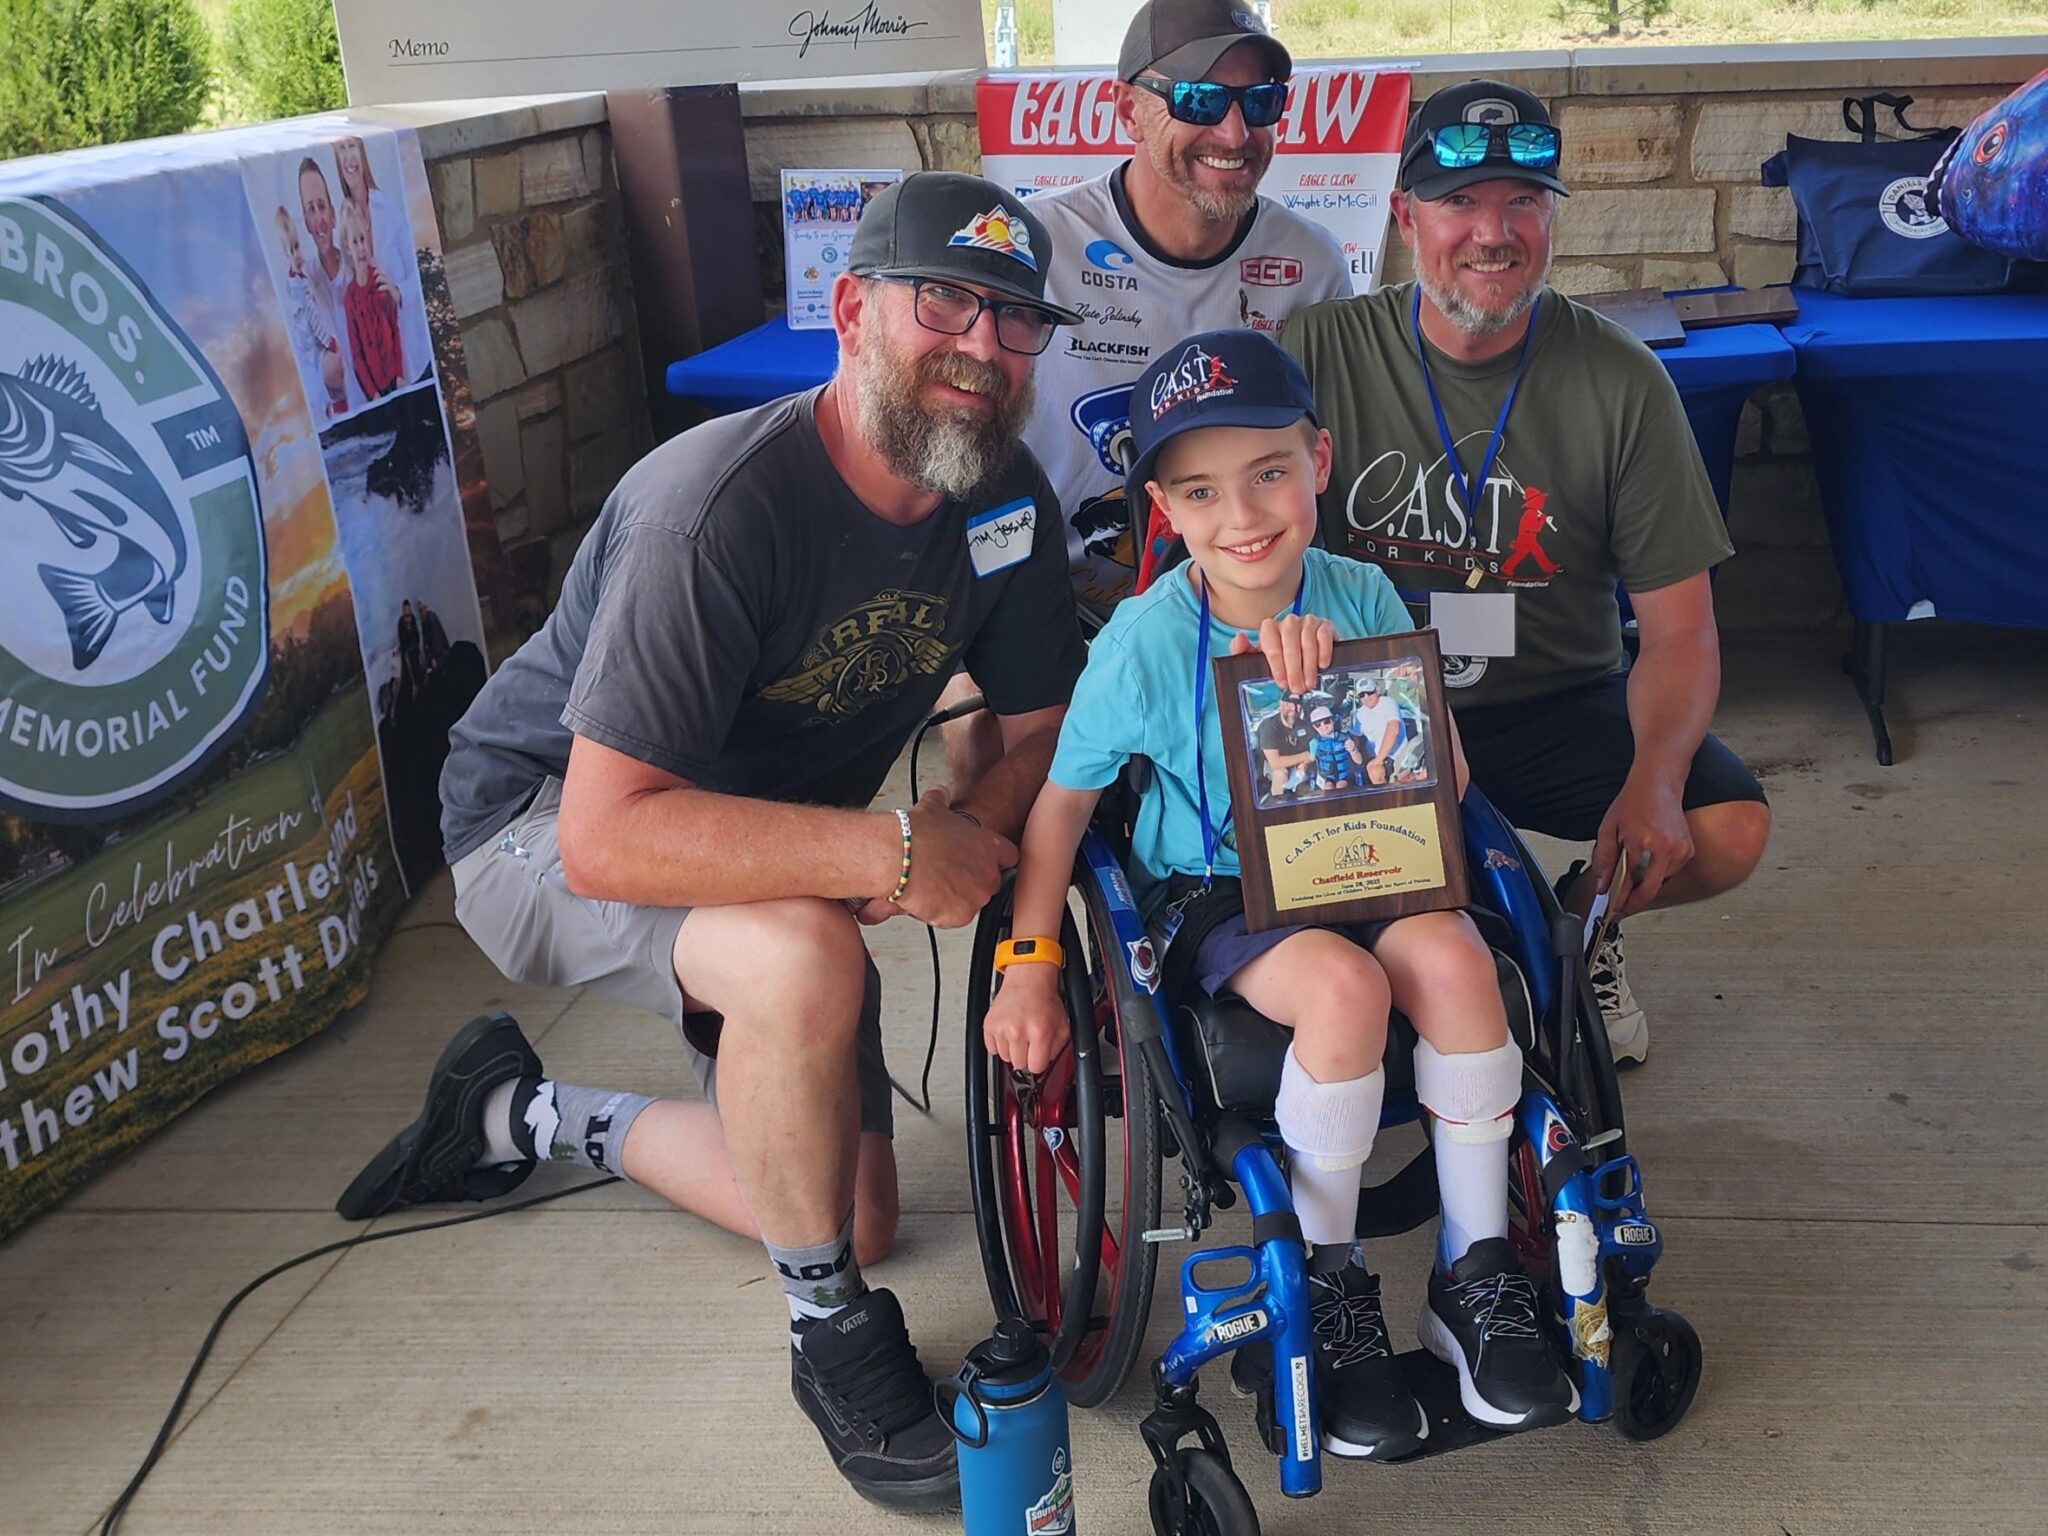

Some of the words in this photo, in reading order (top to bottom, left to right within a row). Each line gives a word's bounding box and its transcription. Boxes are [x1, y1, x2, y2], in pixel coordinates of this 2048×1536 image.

[788, 10, 860, 58] Johnny
[846, 0, 928, 34] Morris
[389, 38, 449, 58] Memo
[1273, 72, 1378, 145] AW
[1034, 175, 1058, 186] EAGLE
[1299, 173, 1327, 187] EAGLE
[1329, 173, 1356, 186] CLAW
[1888, 180, 1923, 201] DANIELS
[1282, 193, 1321, 210] Wright
[1338, 193, 1378, 209] McGill
[1081, 270, 1139, 291] COSTA
[0, 215, 146, 385] BROS.
[1075, 302, 1101, 319] Nate
[1099, 305, 1143, 329] Zelinsky
[1251, 319, 1273, 331] EAGLE
[1064, 335, 1149, 357] BLACKFISH
[185, 424, 222, 451] TIM
[1347, 533, 1399, 559] FOR
[1424, 549, 1501, 574] KIDS
[189, 575, 250, 697] FUND
[1285, 831, 1324, 865] C.A.S.T.
[1325, 827, 1341, 838] for
[1344, 820, 1367, 831] Kids
[1370, 819, 1427, 846] Foundation
[1311, 872, 1354, 886] Chatfield
[1356, 865, 1402, 880] Reservoir
[8, 926, 57, 1005] In
[85, 813, 303, 948] Celebration
[0, 969, 131, 1090] othy
[151, 848, 341, 982] Charles
[156, 943, 304, 1062] Scott
[1623, 1226, 1652, 1243] ROGUE
[836, 1309, 871, 1335] VANS
[1215, 1314, 1259, 1342] ROGUE
[1294, 1370, 1310, 1457] #HELMETSARECOOL
